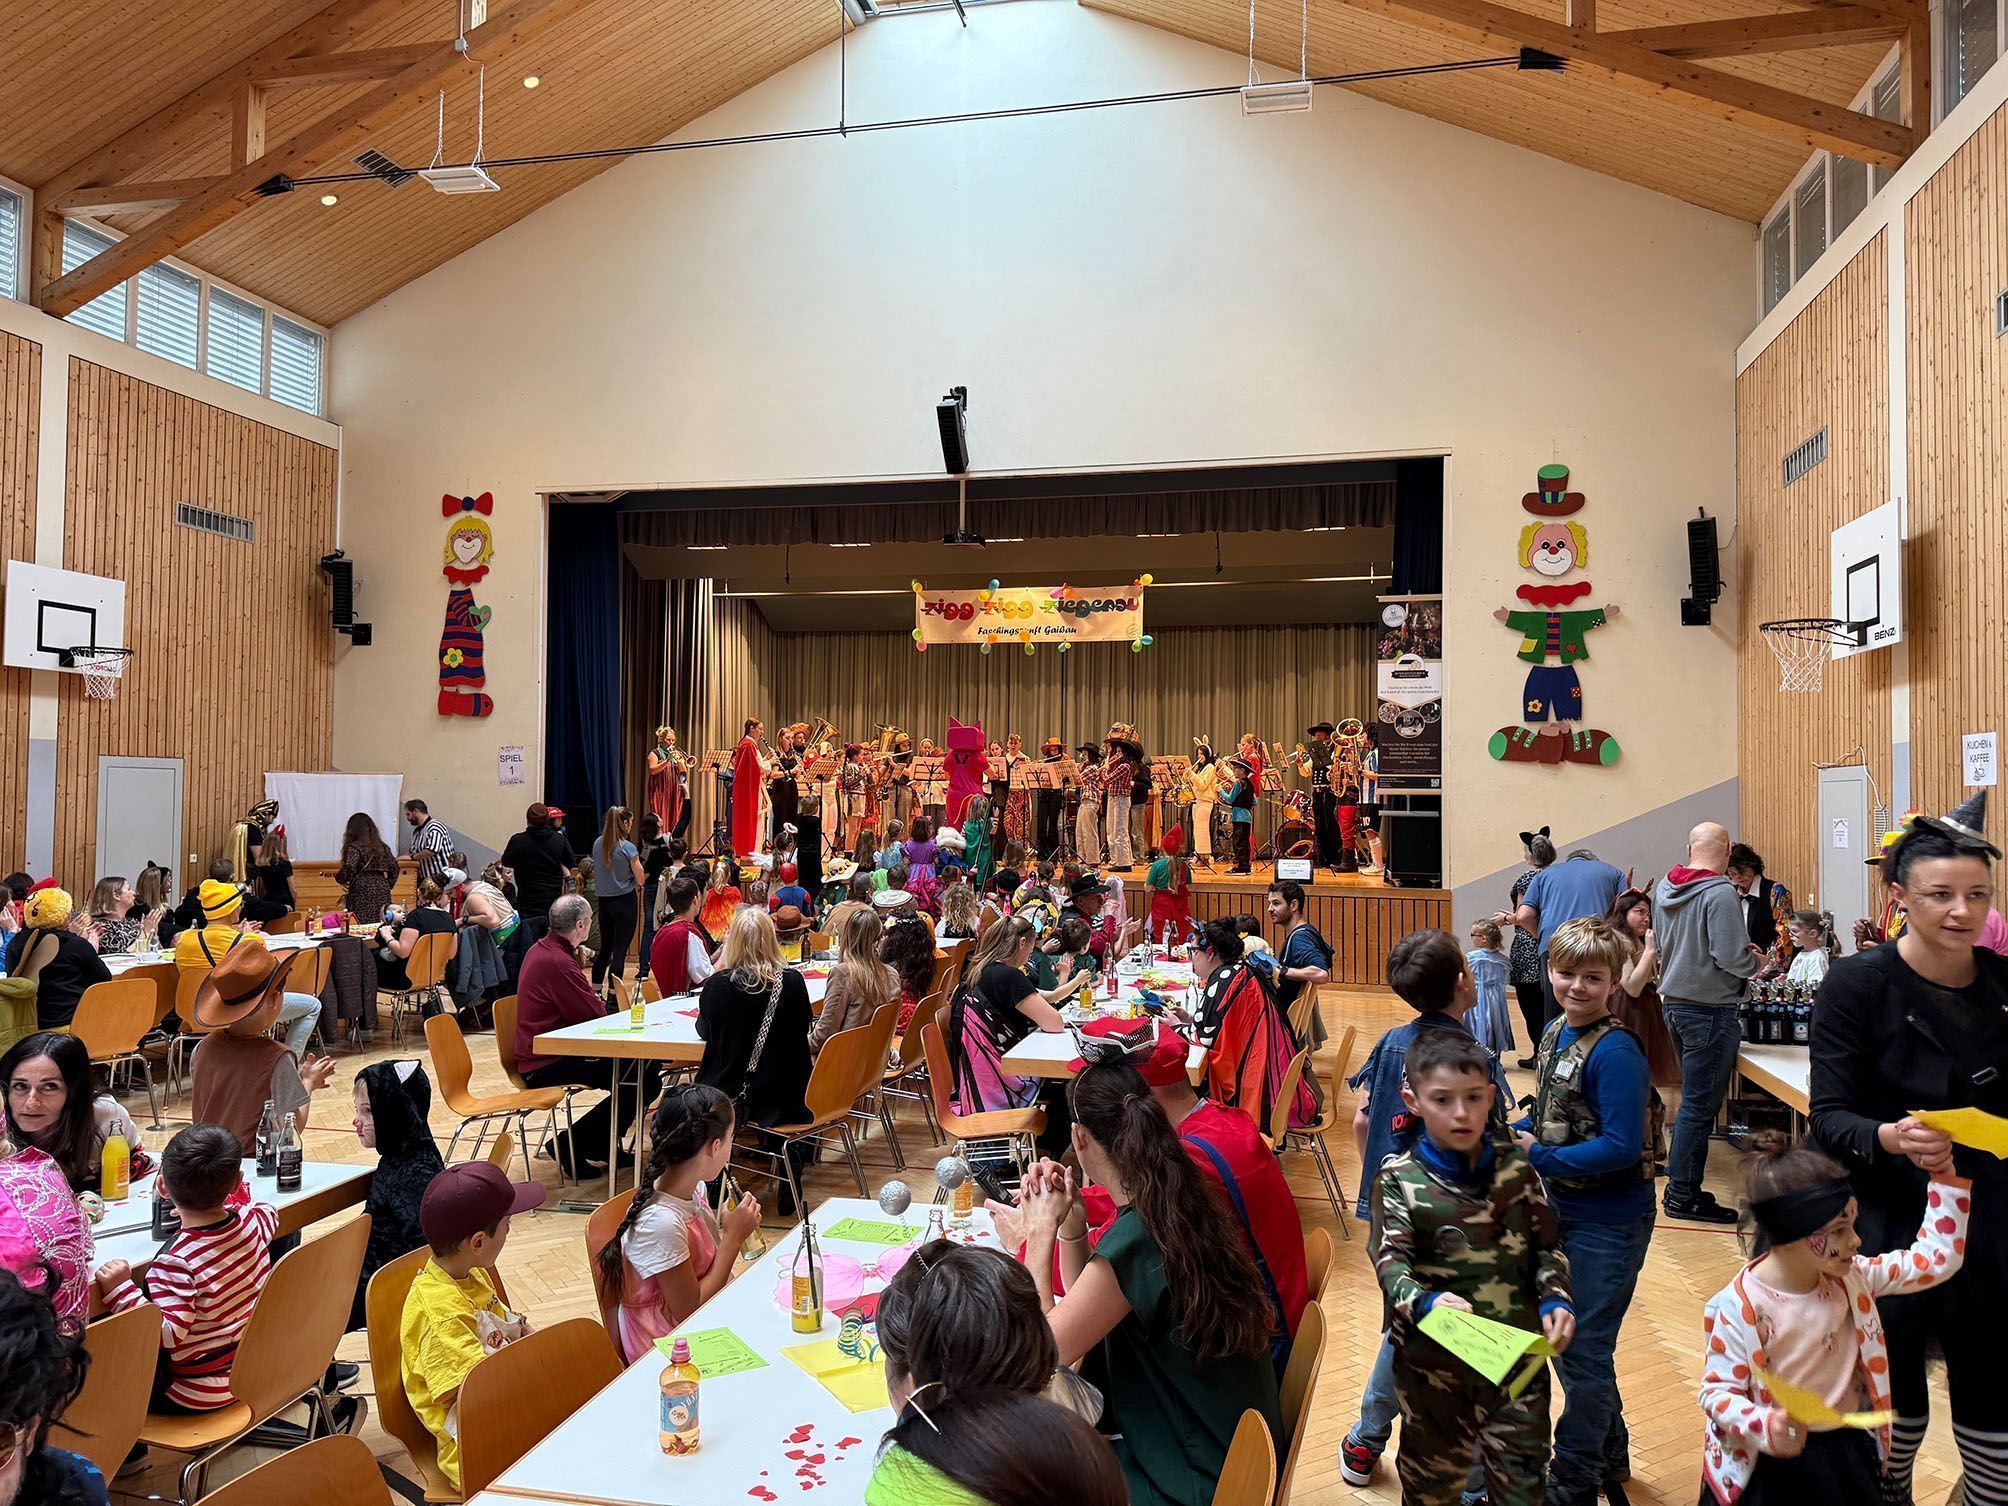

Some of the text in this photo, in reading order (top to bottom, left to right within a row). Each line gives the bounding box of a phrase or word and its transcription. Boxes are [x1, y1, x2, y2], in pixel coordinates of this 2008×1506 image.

[1874, 627, 1896, 641] BENZ
[499, 754, 524, 763] SPIEL
[1970, 753, 1989, 763] KAFFEE
